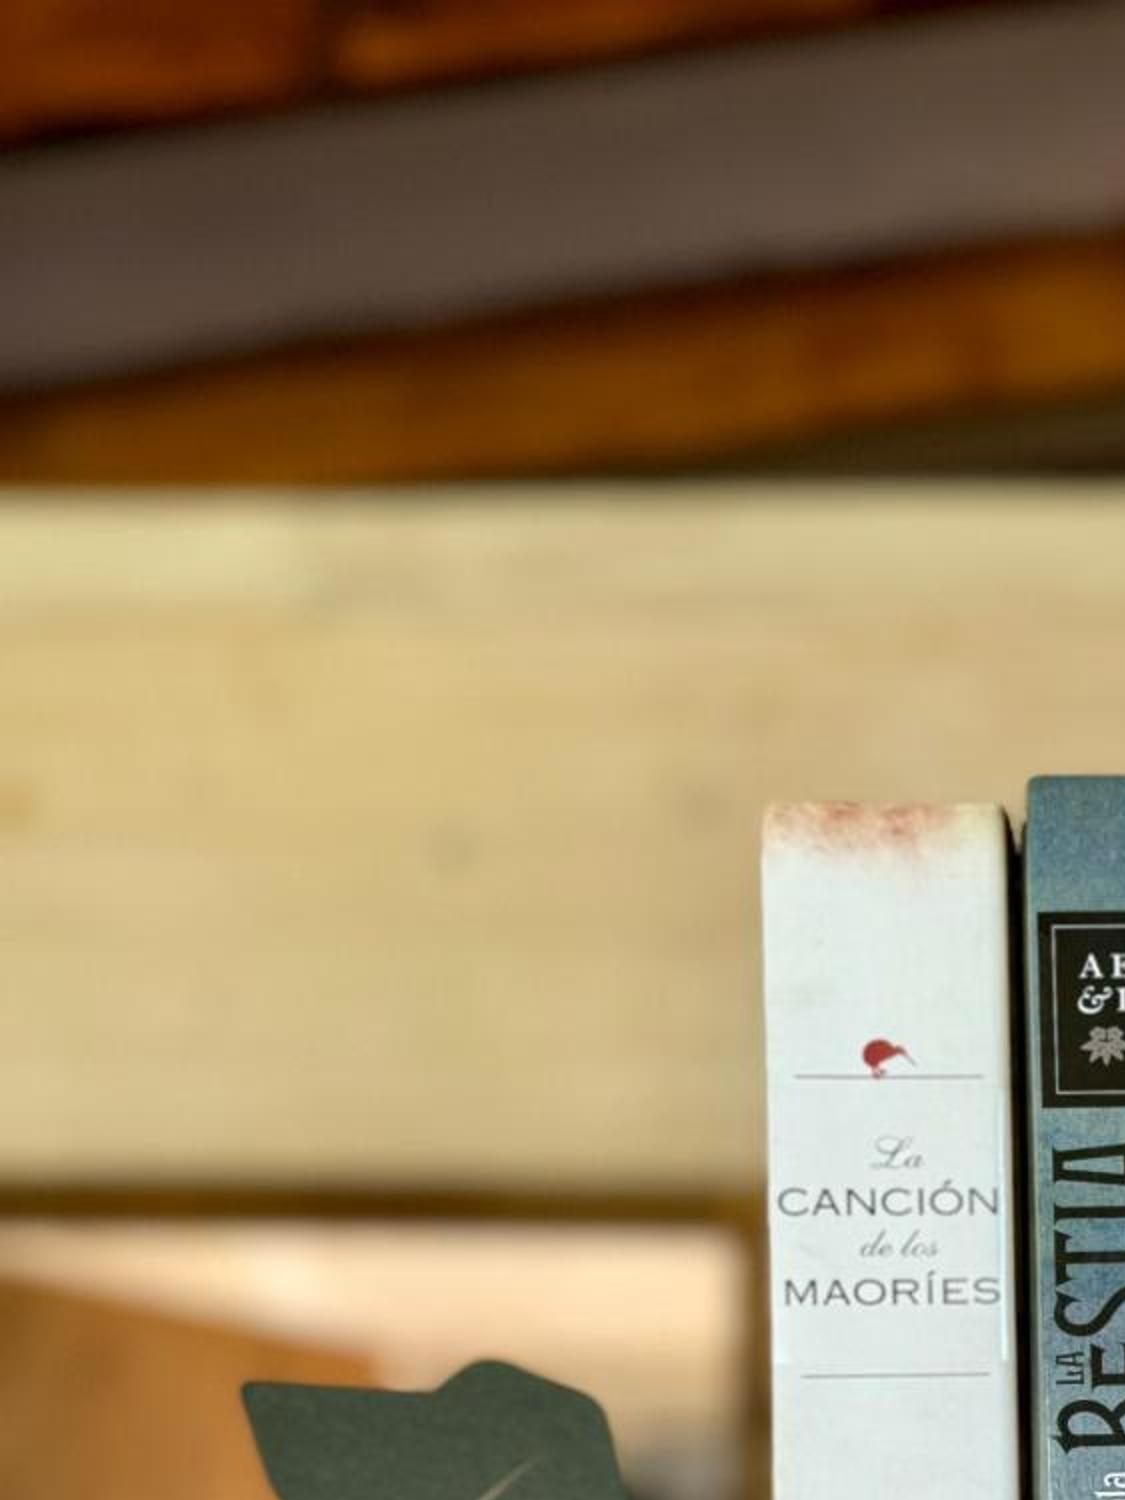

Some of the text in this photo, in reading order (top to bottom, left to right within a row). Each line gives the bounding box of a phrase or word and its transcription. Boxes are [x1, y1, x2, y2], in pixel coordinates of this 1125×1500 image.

[868, 1135, 926, 1170] La
[776, 1179, 1000, 1218] CANCIÓN
[859, 1229, 940, 1259] de los
[783, 1270, 1002, 1307] MAORÍES
[1055, 1351, 1085, 1385] LA
